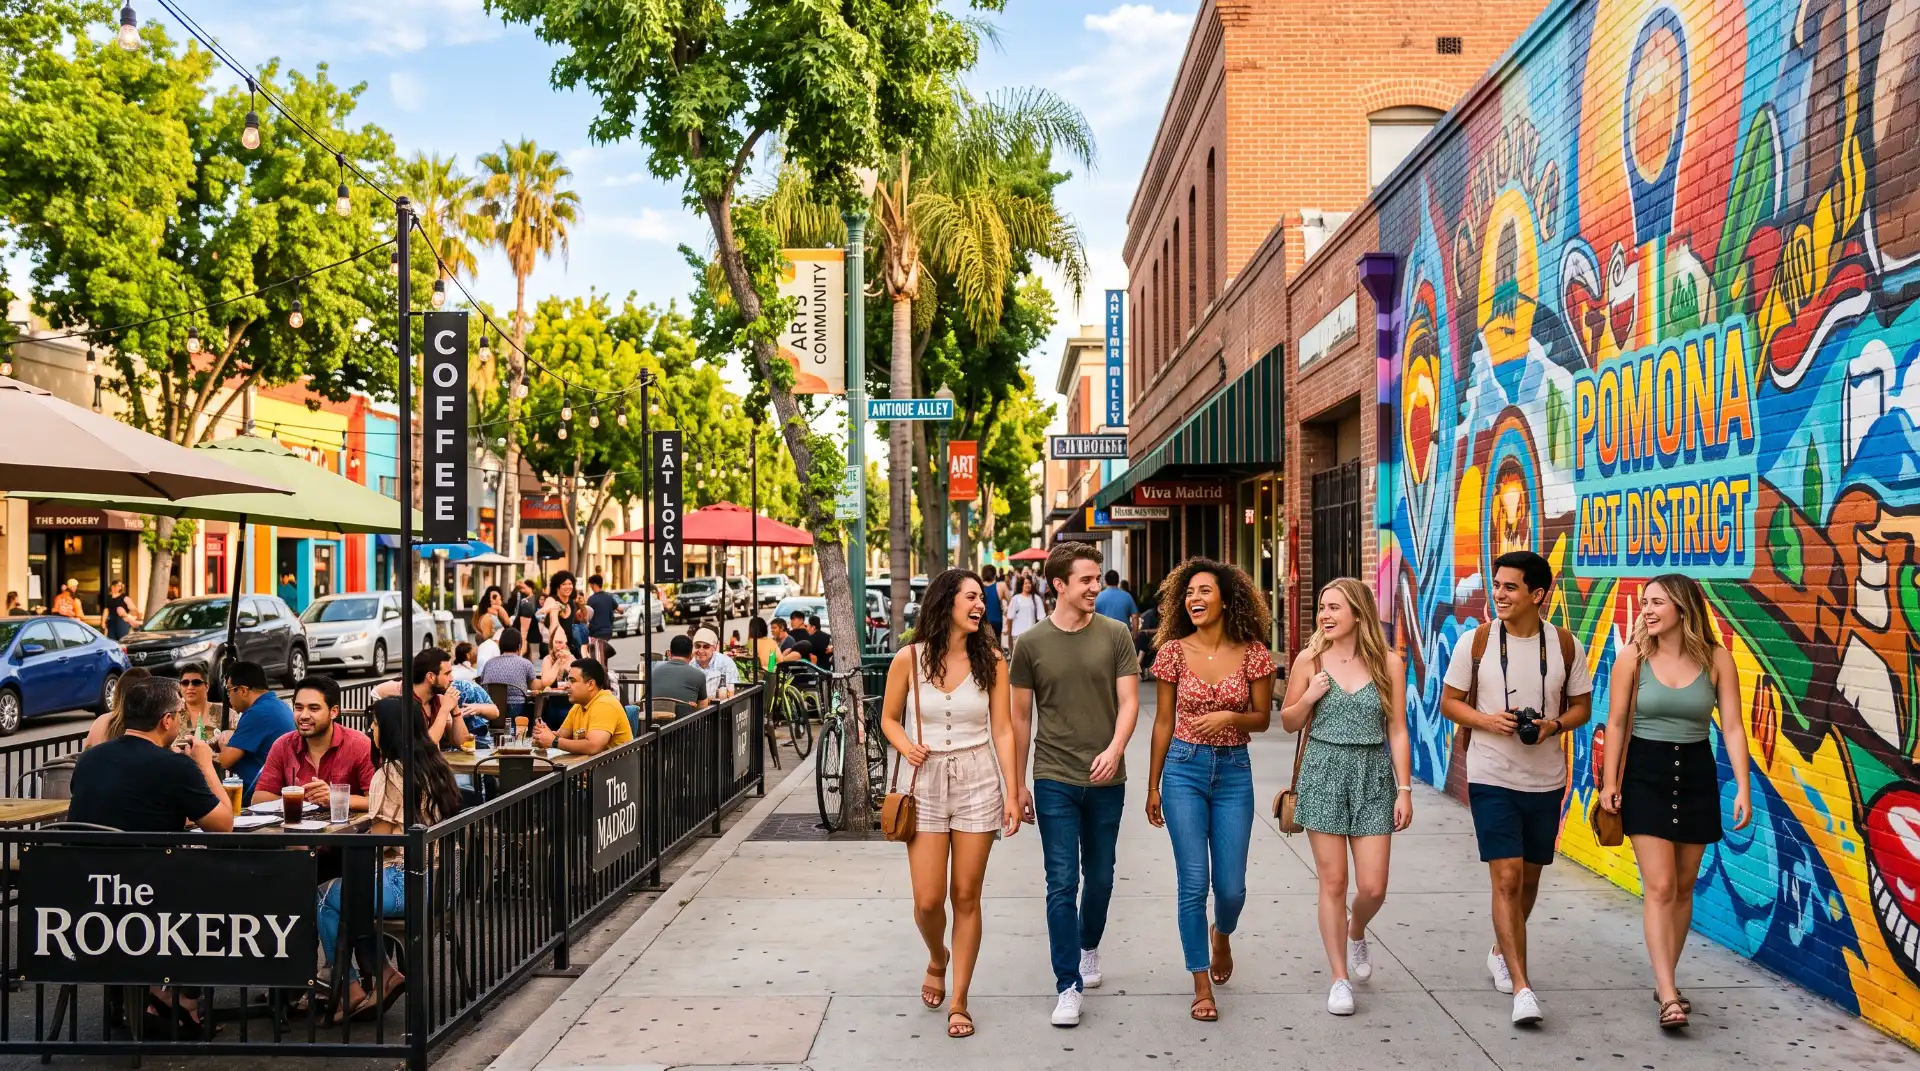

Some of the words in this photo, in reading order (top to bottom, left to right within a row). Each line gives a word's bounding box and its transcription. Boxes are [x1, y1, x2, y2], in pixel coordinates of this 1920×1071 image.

[813, 263, 827, 365] COMMUNITY
[433, 329, 459, 521] COFFEE
[872, 402, 914, 417] ANTIQUE
[917, 402, 948, 416] ALLEY
[1576, 325, 1754, 476] POMONA
[661, 438, 675, 485] EAT
[951, 455, 975, 474] ART
[1141, 486, 1171, 499] Viva
[1175, 486, 1223, 499] Madrid
[35, 516, 54, 525] THE
[56, 516, 100, 526] ROOKERY
[661, 492, 676, 573] LOCAL
[1578, 493, 1622, 559] ART
[1627, 478, 1749, 558] DISTRICT
[606, 776, 628, 808] The
[597, 801, 637, 854] MADRID
[88, 873, 154, 906] The
[34, 907, 300, 961] ROOKERY
